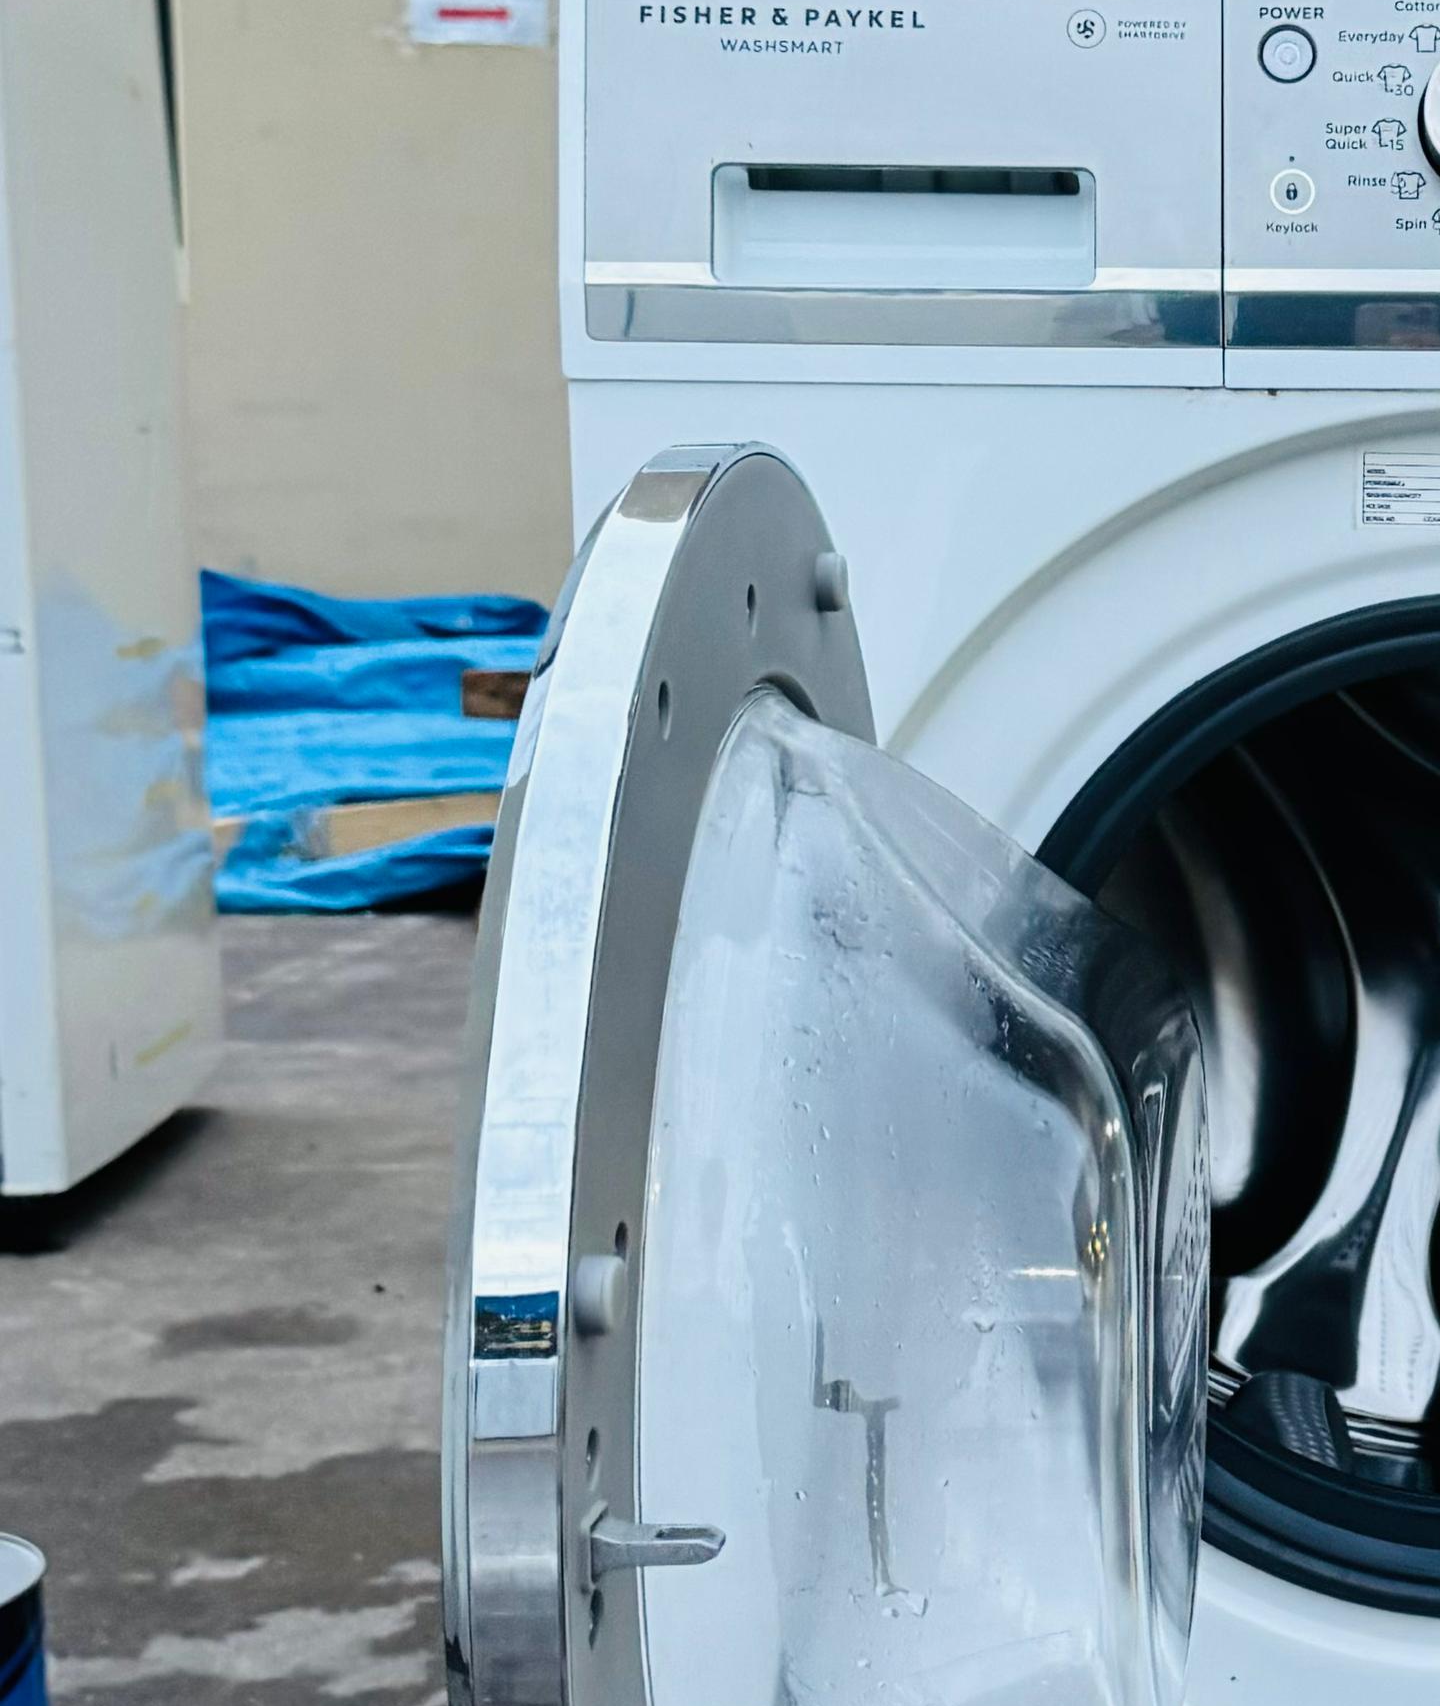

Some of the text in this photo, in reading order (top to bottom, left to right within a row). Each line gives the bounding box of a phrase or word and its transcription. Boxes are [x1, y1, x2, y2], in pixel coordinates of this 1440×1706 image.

[639, 5, 925, 29] FISHER & PAYKEL
[1259, 6, 1324, 20] POWER
[1118, 20, 1170, 29] POWERED
[1338, 30, 1404, 44] Everyday
[720, 37, 843, 54] WASHSMART
[1332, 71, 1374, 83] Quick
[1395, 84, 1414, 96] 30
[1325, 122, 1367, 136] Super
[1325, 138, 1368, 150] Quick
[1348, 175, 1386, 187] Rinse
[1266, 221, 1319, 235] Keylock
[1396, 218, 1427, 230] Spin
